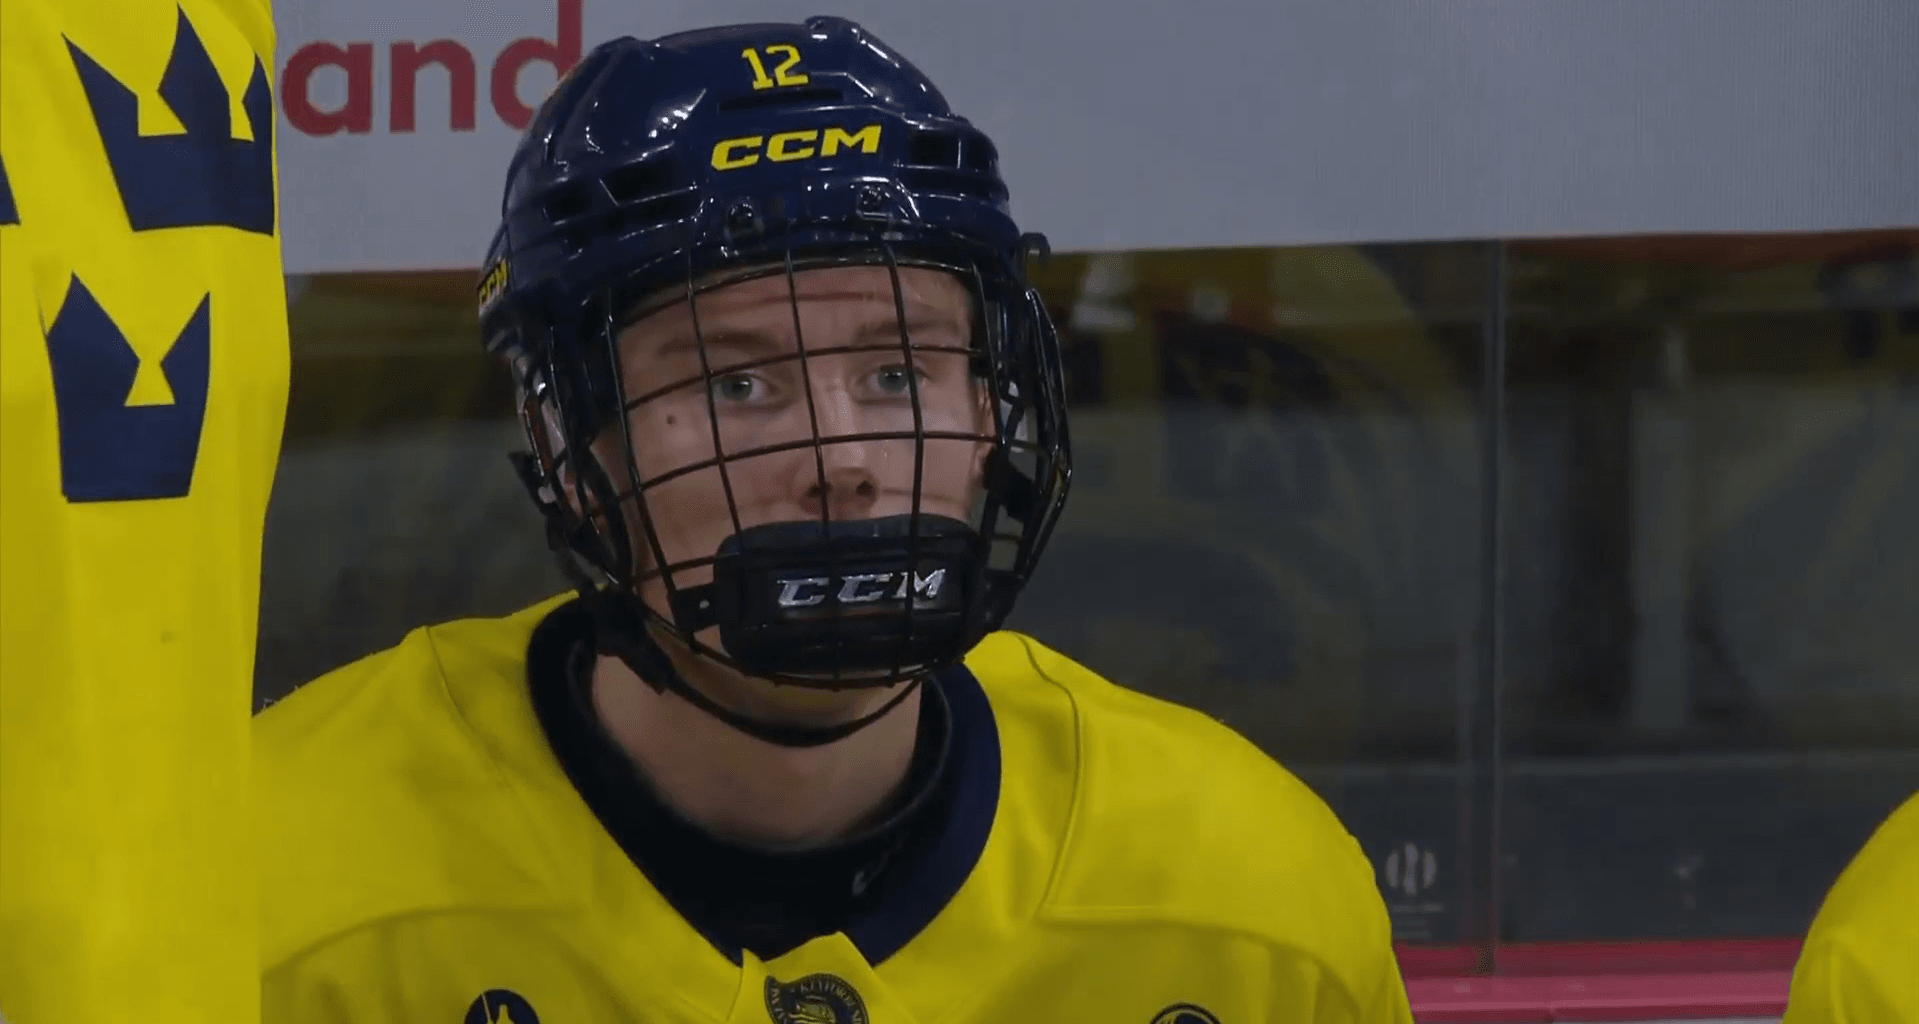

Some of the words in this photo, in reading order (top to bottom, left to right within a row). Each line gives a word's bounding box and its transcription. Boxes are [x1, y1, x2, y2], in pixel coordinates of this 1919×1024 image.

[281, 0, 582, 136] and
[742, 44, 810, 91] 12
[711, 125, 882, 171] CCM
[777, 568, 947, 607] CCM
